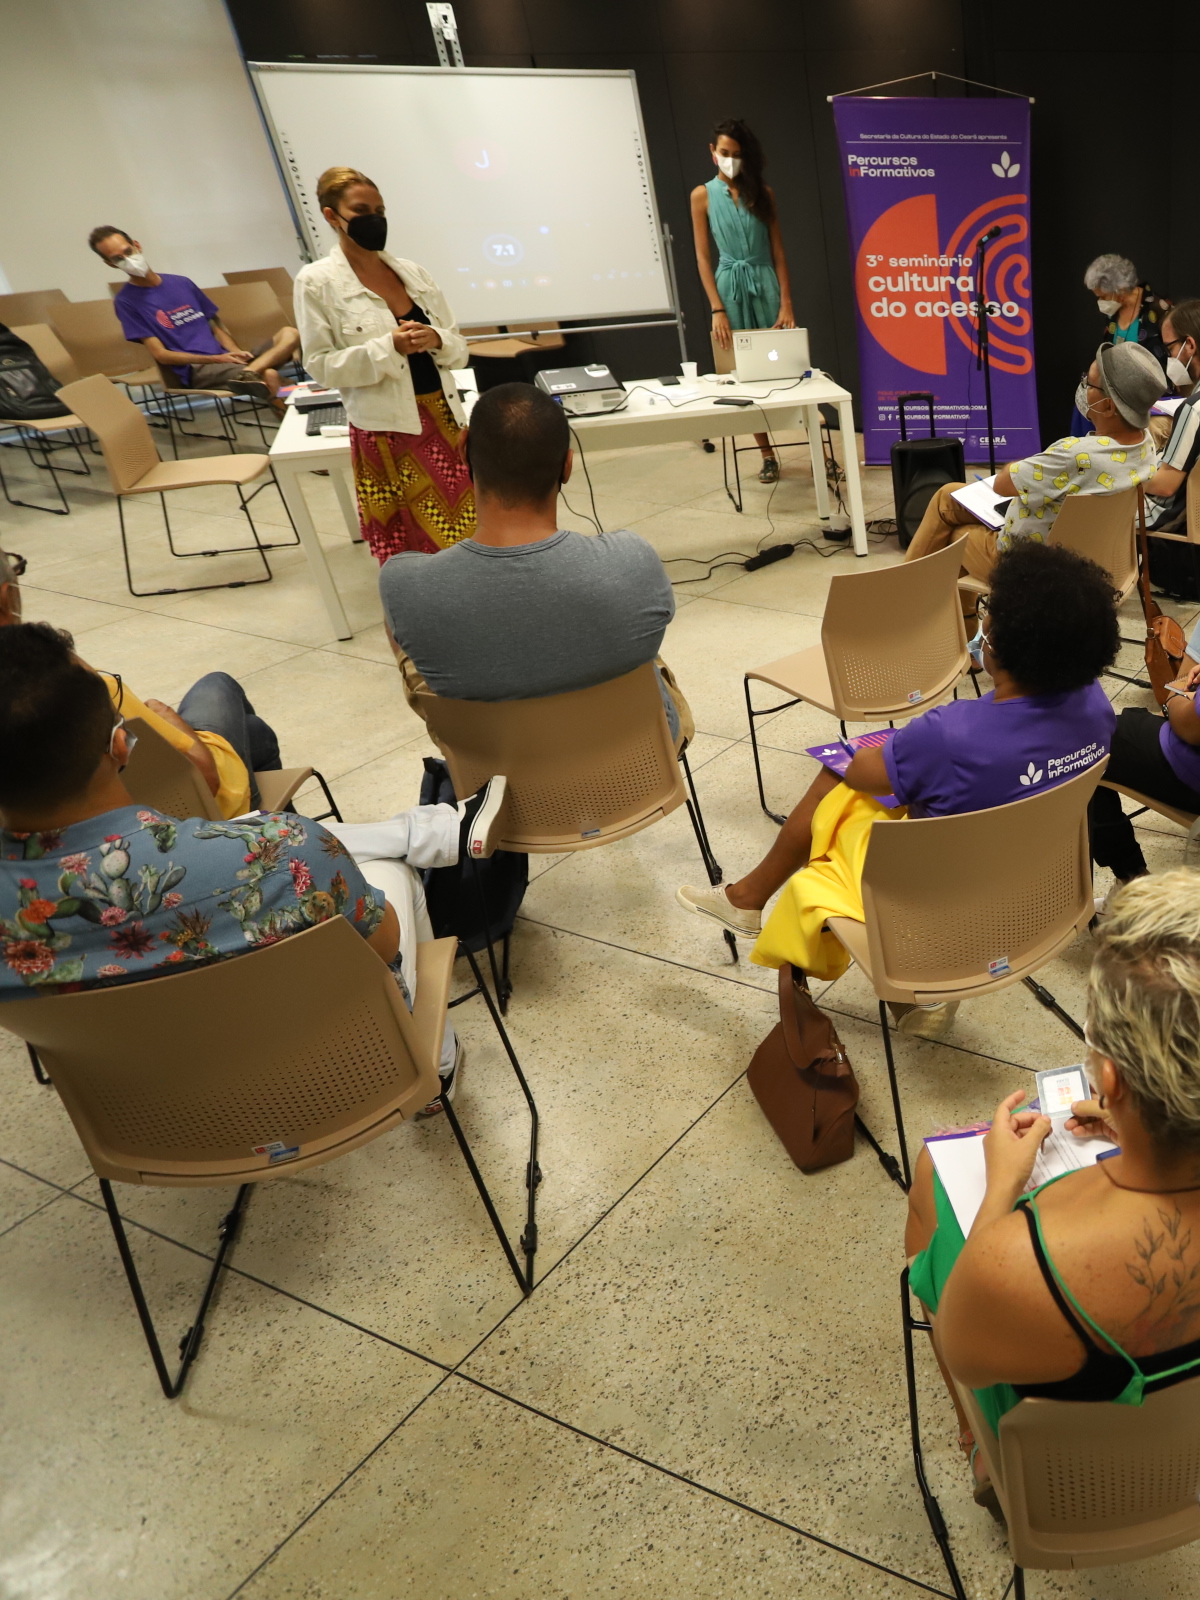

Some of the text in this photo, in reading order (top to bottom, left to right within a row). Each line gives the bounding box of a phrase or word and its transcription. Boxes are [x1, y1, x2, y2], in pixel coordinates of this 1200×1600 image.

[847, 154, 918, 166] Percursos
[849, 166, 935, 178] inFormativos
[888, 254, 973, 268] seminário
[868, 271, 974, 292] cultura
[870, 297, 1020, 318] do acesso
[979, 434, 1007, 443] CERÁ
[1047, 742, 1097, 770] Percursos
[1047, 745, 1105, 780] inFormativos
